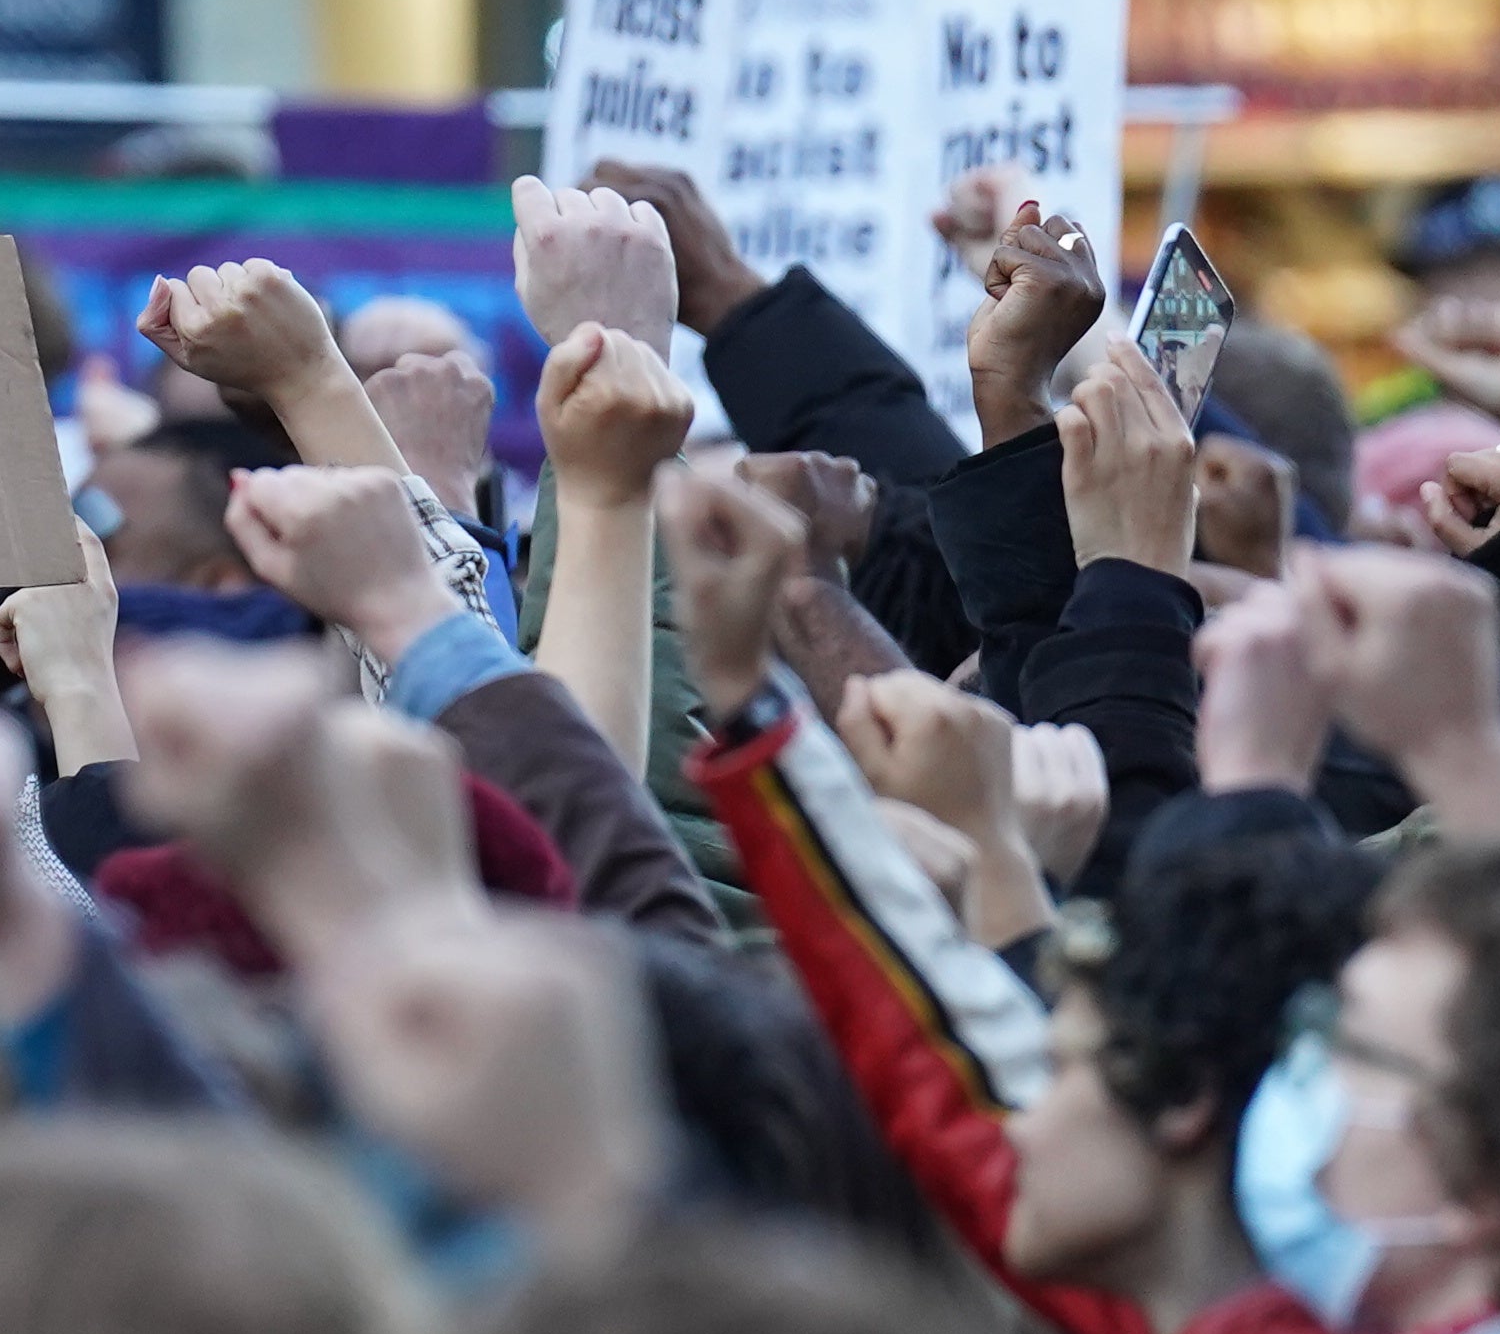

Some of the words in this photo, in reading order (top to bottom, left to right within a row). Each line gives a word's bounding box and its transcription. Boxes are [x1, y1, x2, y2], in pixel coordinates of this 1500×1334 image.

[940, 14, 991, 88] No
[1014, 9, 1066, 84] to
[577, 57, 694, 142] police
[728, 124, 877, 182] acist
